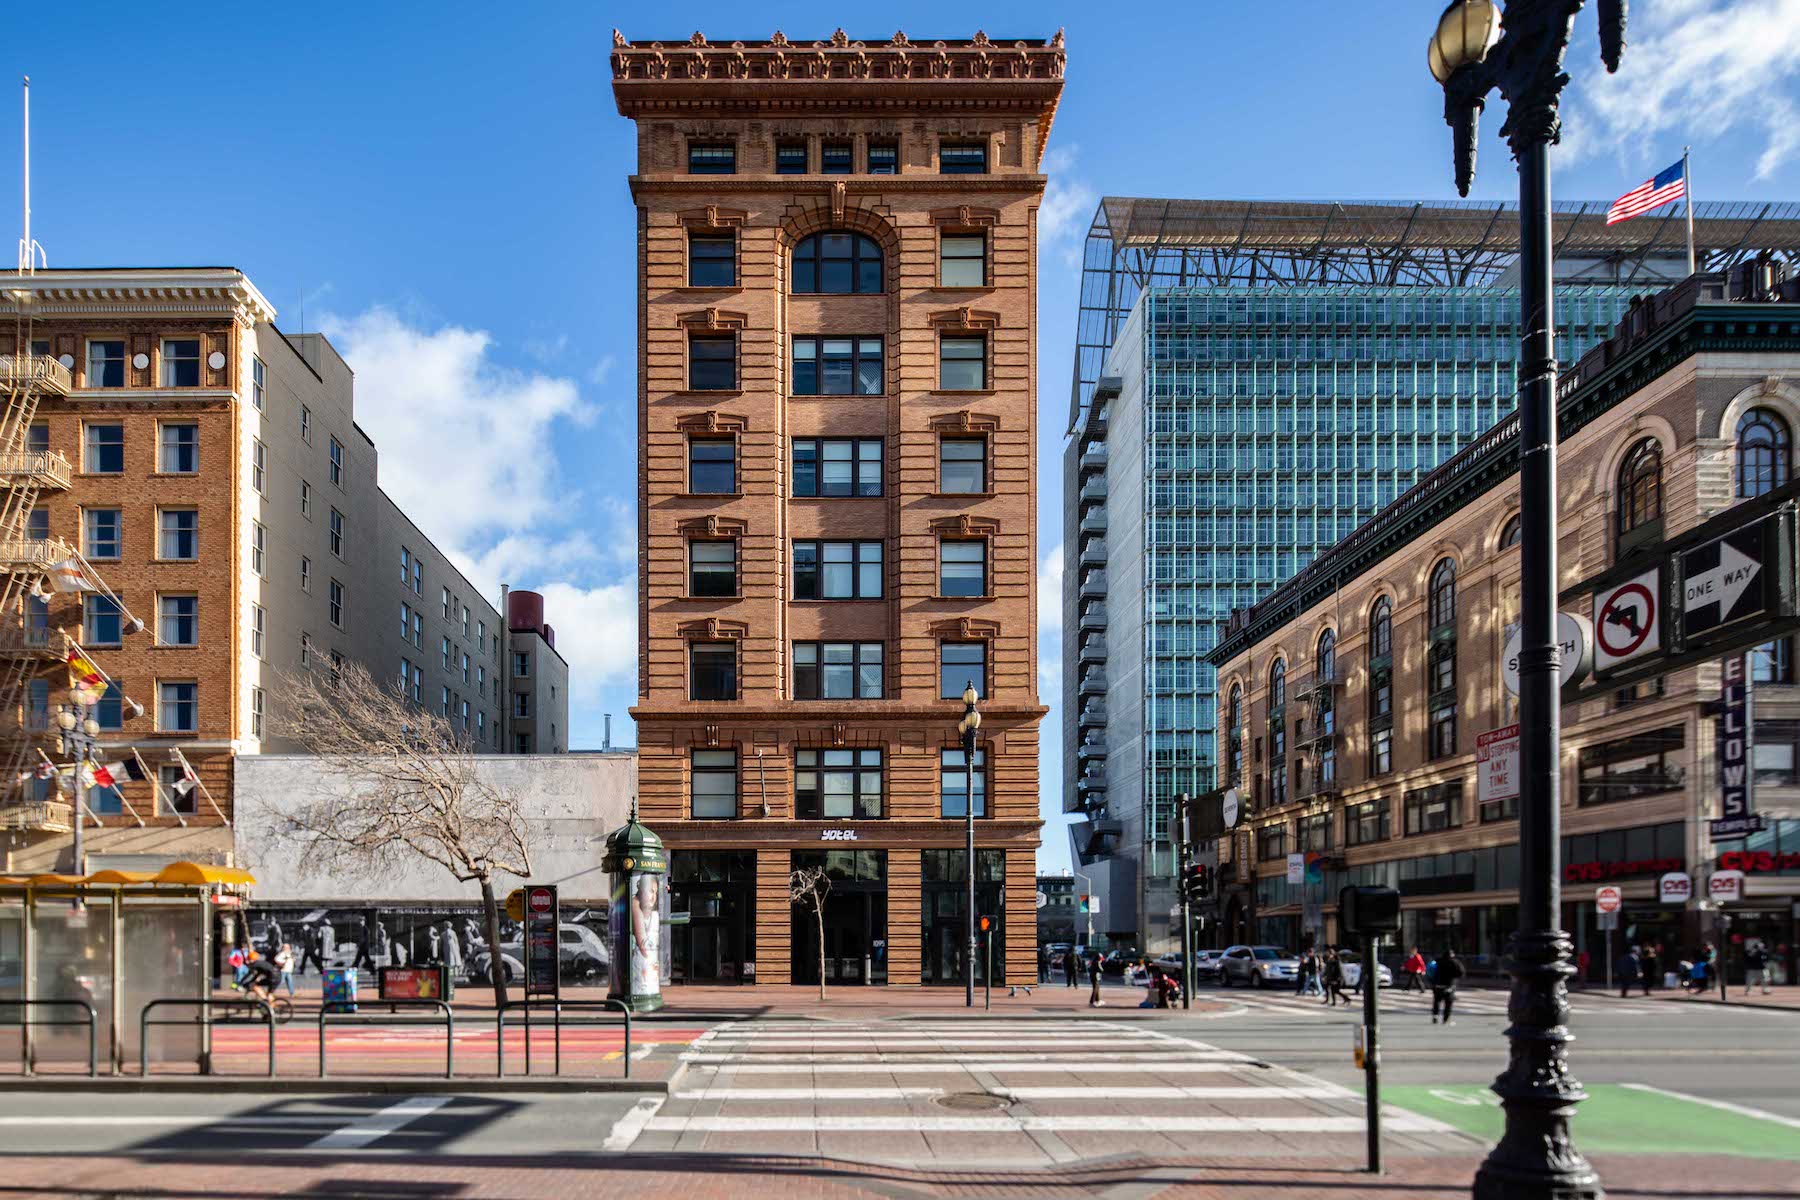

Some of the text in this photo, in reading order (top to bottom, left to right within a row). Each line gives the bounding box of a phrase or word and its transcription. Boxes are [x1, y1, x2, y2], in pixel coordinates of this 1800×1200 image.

[1687, 564, 1753, 601] ONE WAY
[1490, 759, 1507, 772] ANY
[1489, 773, 1508, 788] TIME
[1663, 880, 1688, 890] CVS
[1711, 878, 1734, 889] CVS
